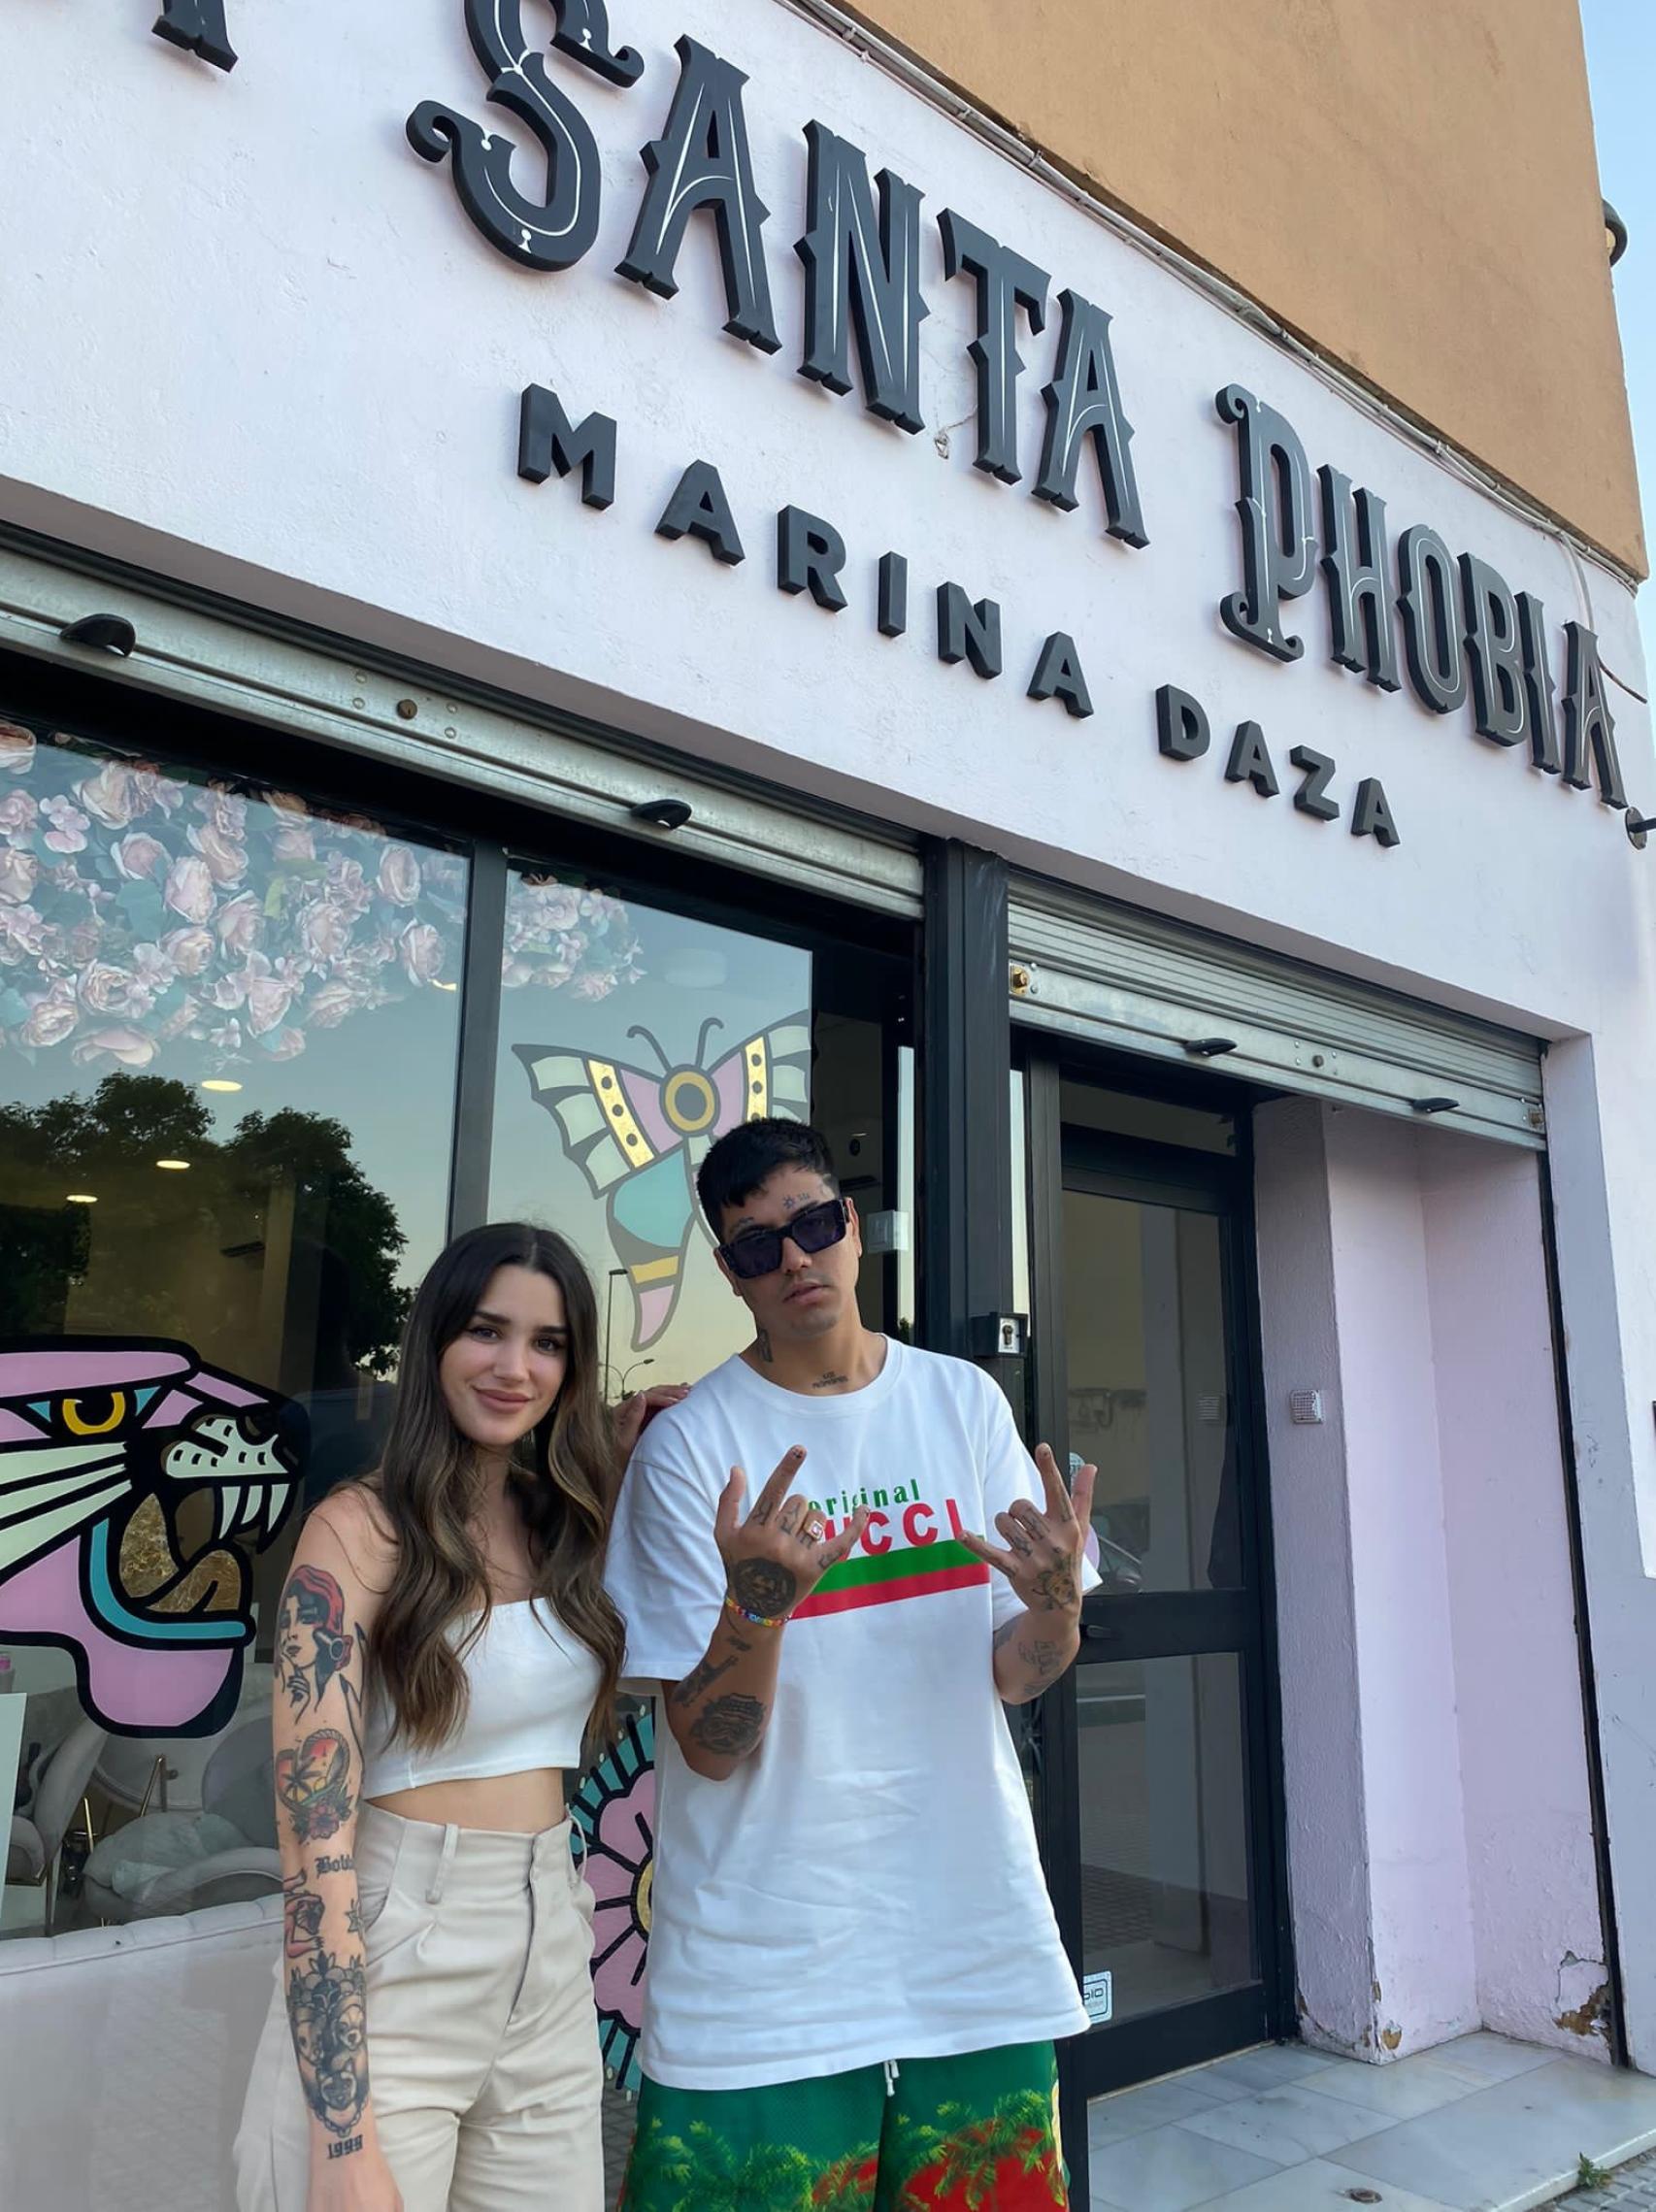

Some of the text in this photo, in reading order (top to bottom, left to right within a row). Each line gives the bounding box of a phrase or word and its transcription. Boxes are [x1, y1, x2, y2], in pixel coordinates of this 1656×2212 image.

[406, 0, 1627, 810] SANTA PHOBIA
[517, 382, 1401, 847] MARINA DAZA
[824, 1498, 965, 1562] UCCI
